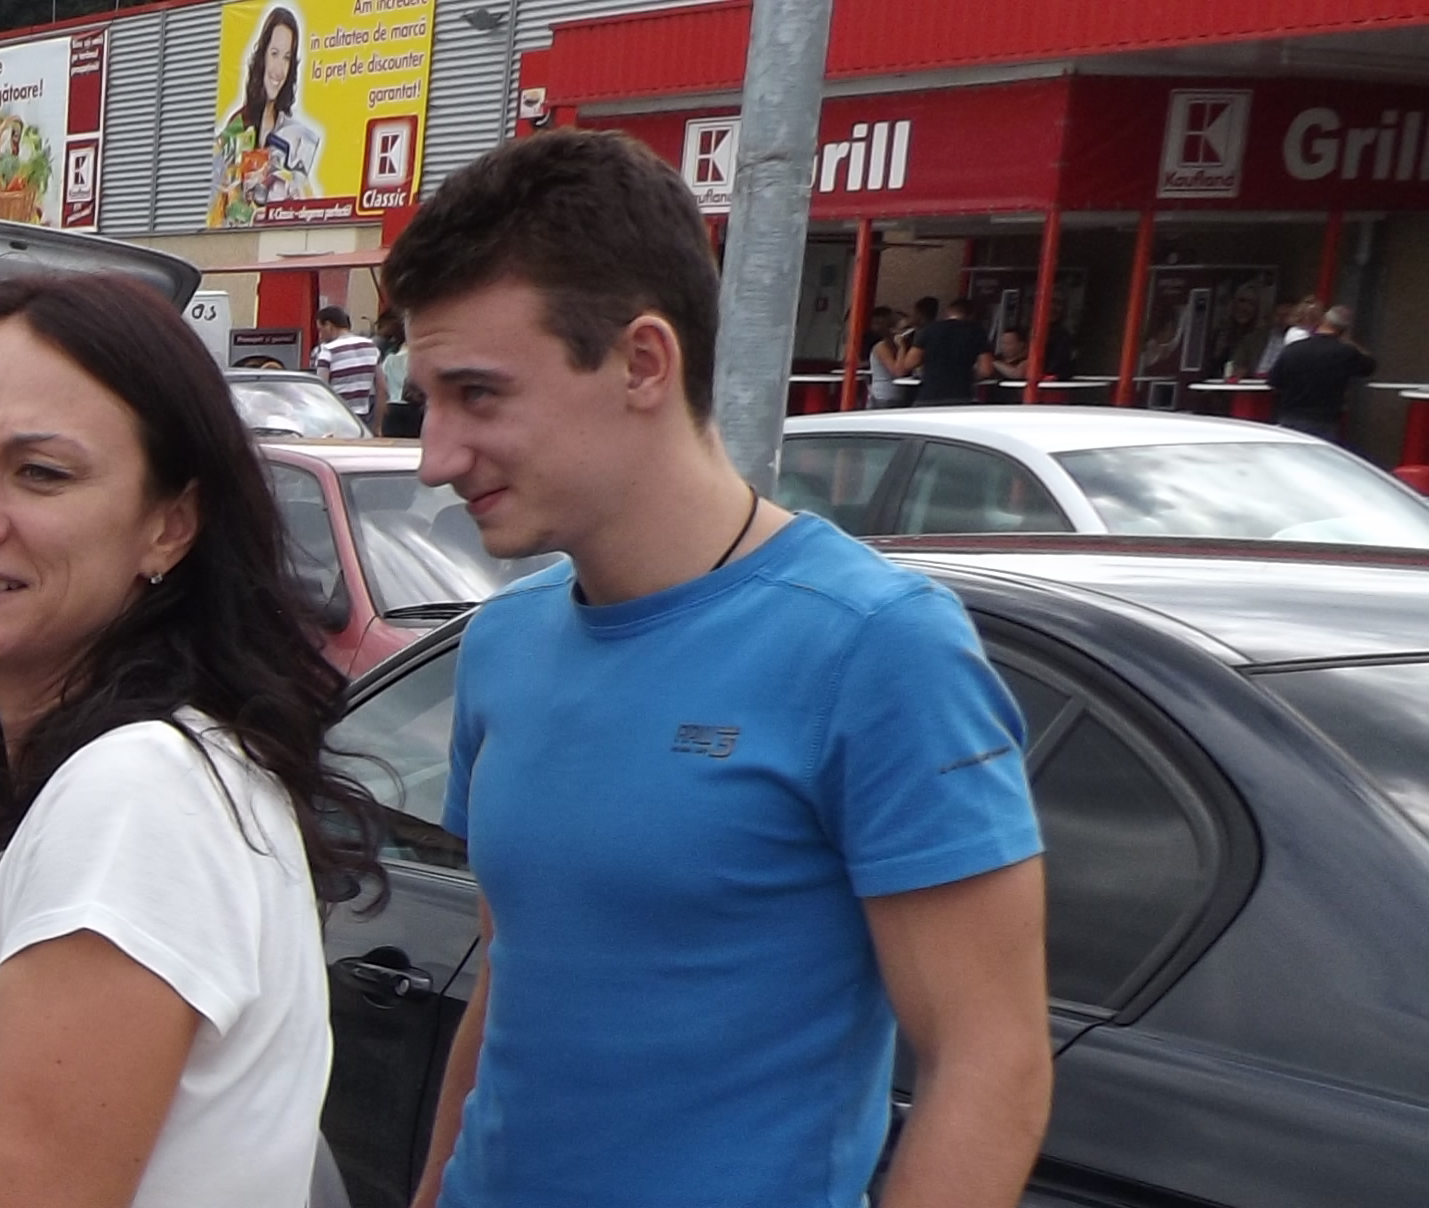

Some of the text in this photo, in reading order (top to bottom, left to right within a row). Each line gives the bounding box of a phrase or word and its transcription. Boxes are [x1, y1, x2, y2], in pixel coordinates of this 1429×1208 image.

[323, 27, 369, 49] calitatea
[373, 21, 387, 42] de
[390, 17, 427, 39] marcă
[349, 55, 364, 75] de
[367, 52, 425, 73] discounter
[368, 79, 421, 108] garantat!
[809, 120, 911, 193] rill
[1164, 170, 1235, 187] Kaufland
[362, 187, 407, 208] Classic
